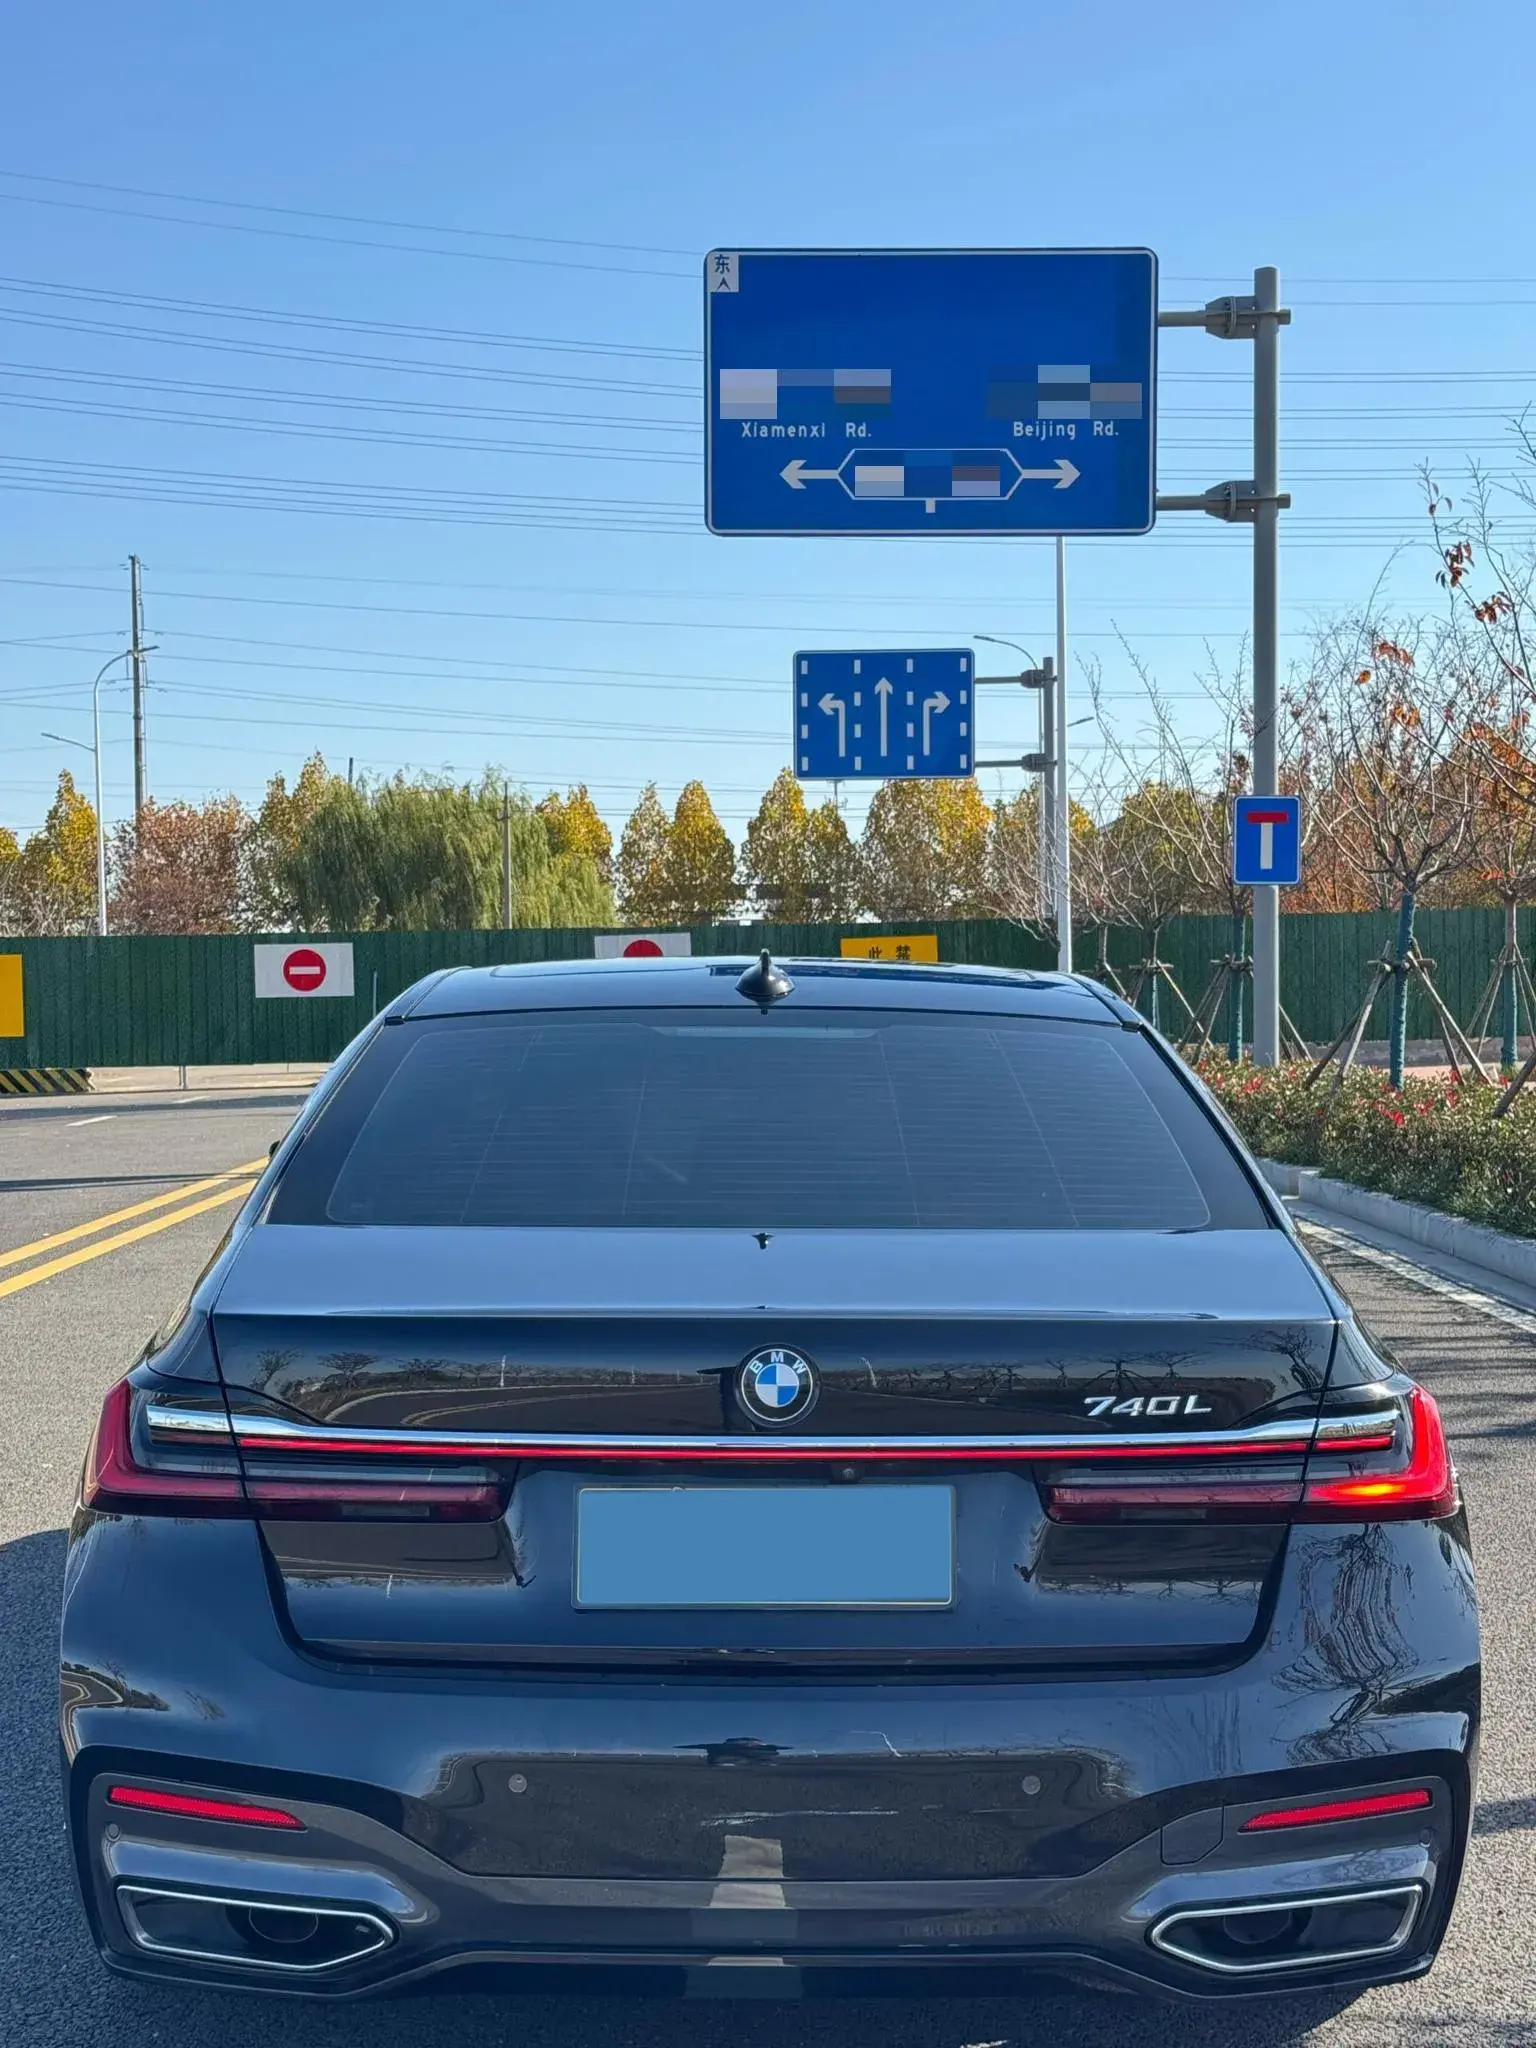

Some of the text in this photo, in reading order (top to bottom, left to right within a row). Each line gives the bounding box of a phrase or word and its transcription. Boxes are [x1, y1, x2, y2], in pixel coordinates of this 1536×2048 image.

[714, 253, 730, 274] 东
[741, 421, 872, 438] Xiamenxi Rd.
[1013, 420, 1119, 441] Beijing Rd.
[749, 1351, 807, 1375] BMW
[1083, 1395, 1212, 1416] 740L
